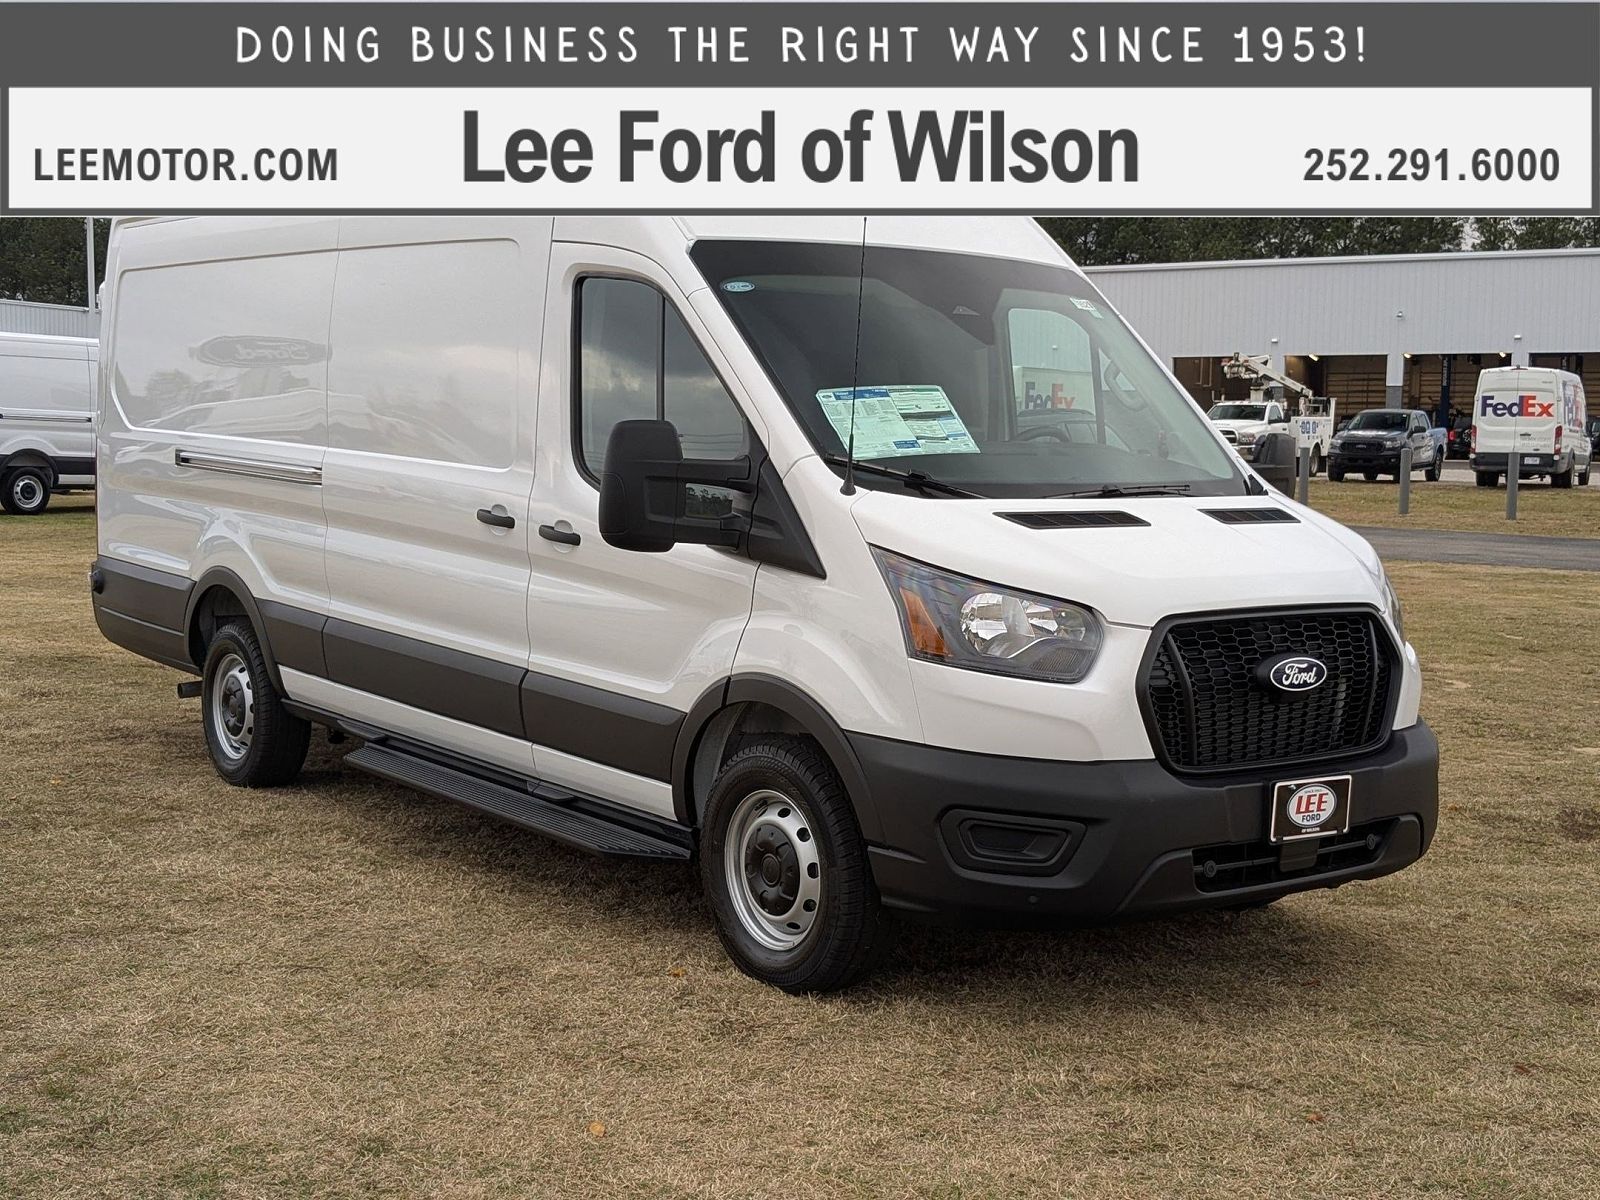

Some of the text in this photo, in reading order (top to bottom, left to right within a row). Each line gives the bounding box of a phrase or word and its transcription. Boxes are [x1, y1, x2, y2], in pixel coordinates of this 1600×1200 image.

[1480, 395, 1555, 418] FedEx
[1281, 662, 1317, 686] Ford
[1295, 792, 1329, 815] LEE
[1301, 813, 1321, 823] FORD
